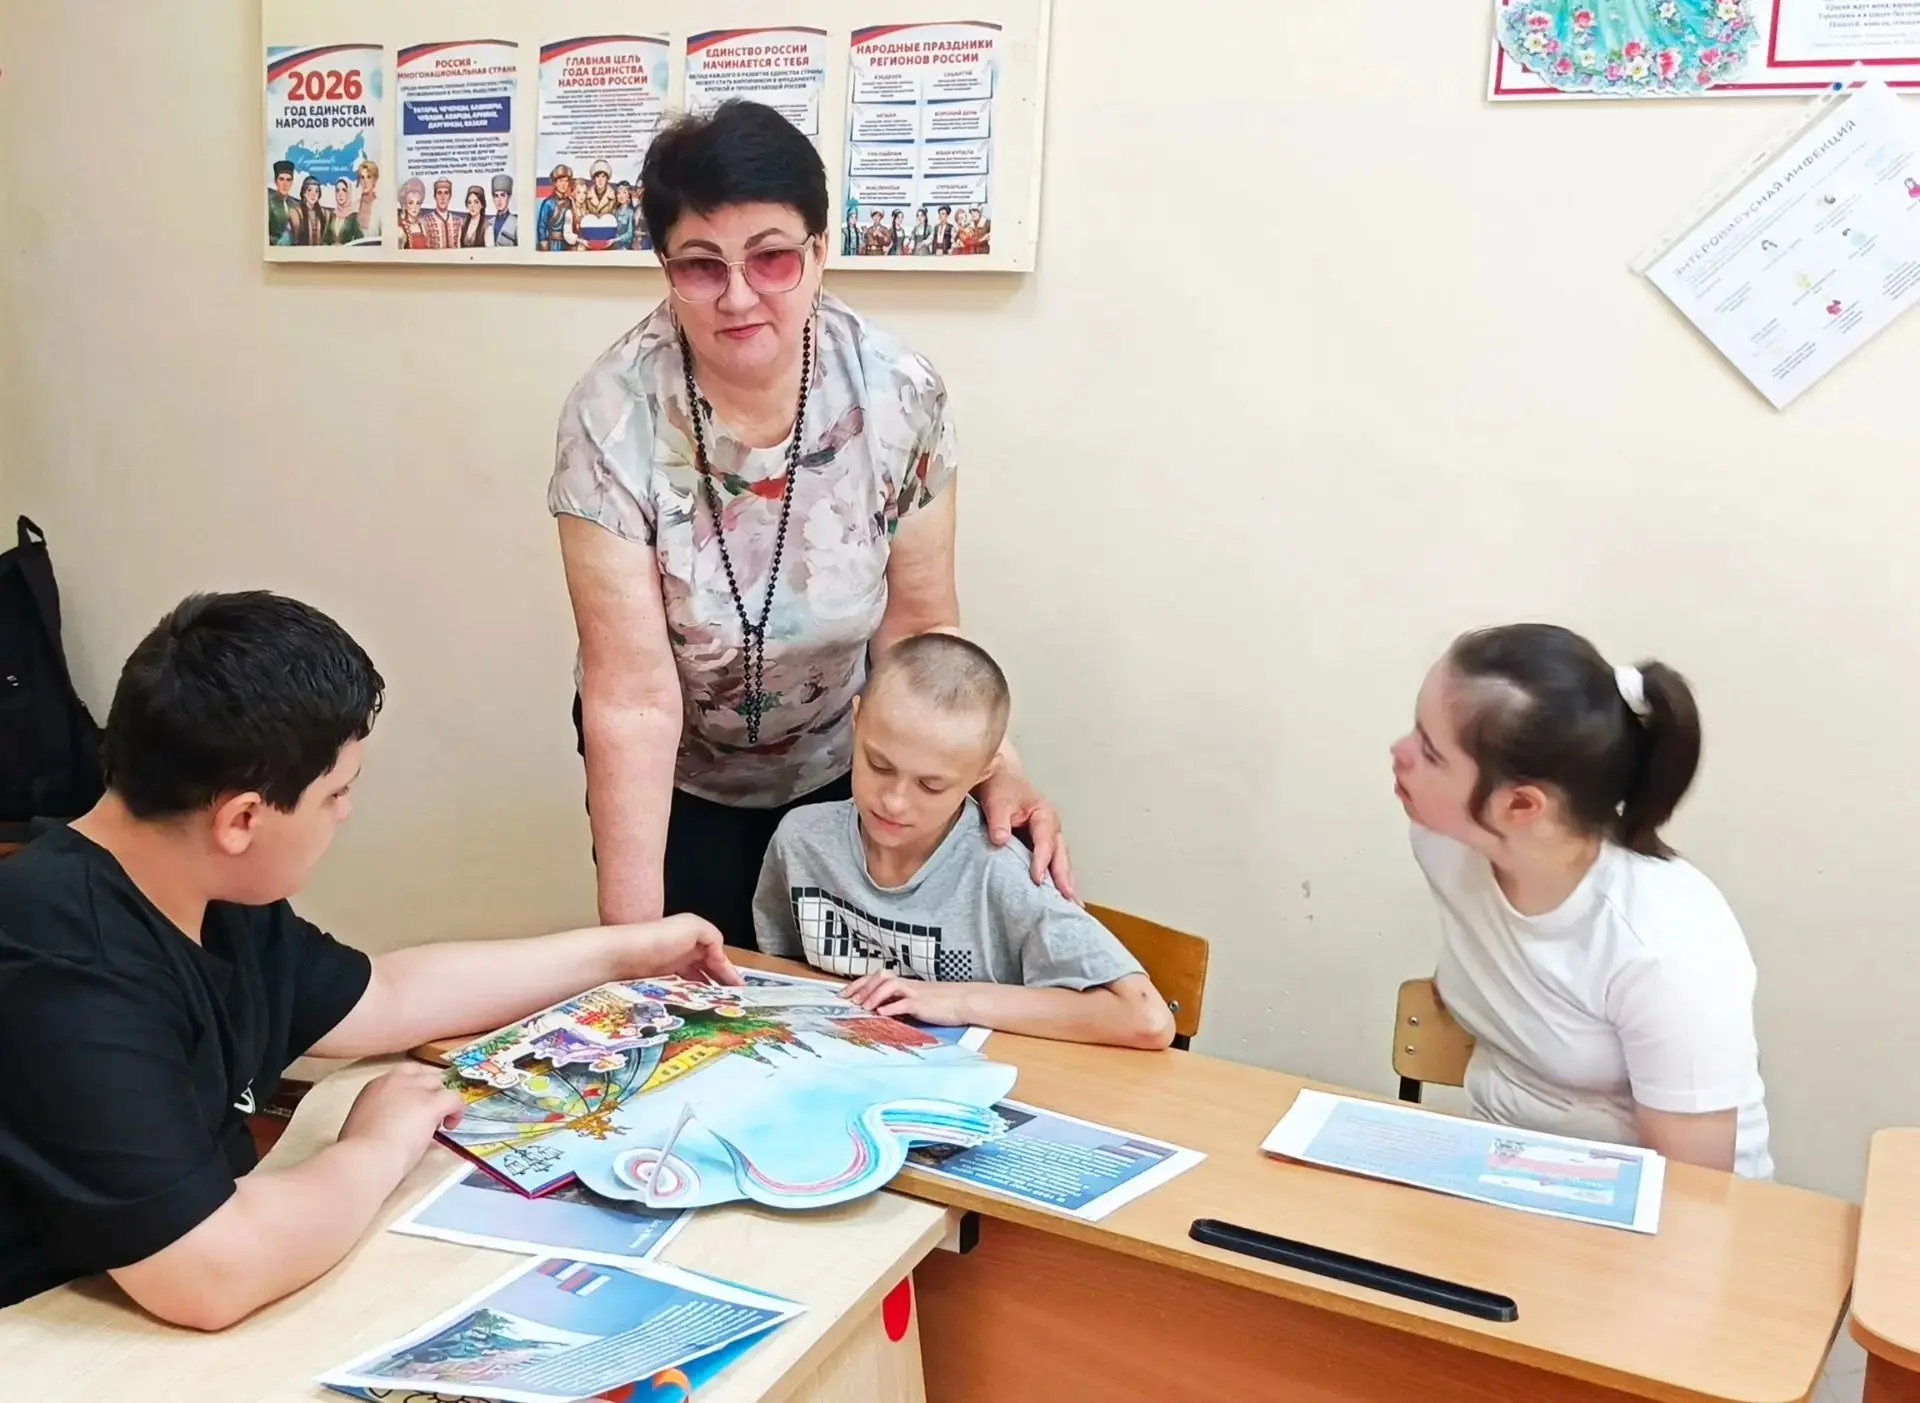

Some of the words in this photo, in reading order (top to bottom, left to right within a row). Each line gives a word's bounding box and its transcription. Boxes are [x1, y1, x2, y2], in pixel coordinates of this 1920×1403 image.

[706, 46, 762, 58] ЕДИНСТВО
[764, 44, 807, 55] РОССИИ
[856, 43, 921, 54] НАРОДНЫЕ
[923, 39, 993, 52] ПРАЗДНИКИ
[435, 58, 471, 68] РОССИЯ
[566, 56, 611, 66] ГЛАВНАЯ
[613, 55, 641, 65] ЦЕЛЬ
[703, 59, 772, 70] НАЧИНАЕТСЯ
[774, 58, 780, 67] С
[784, 57, 809, 67] ТЕБЯ
[870, 55, 930, 67] РЕГИОНОВ
[932, 53, 979, 64] РОССИИ
[397, 68, 486, 80] МНОГОНАЦИОНАЛЬНАЯ
[488, 66, 516, 74] СТРАНА
[562, 67, 589, 76] ГОДА
[591, 65, 644, 76] ЕДИНСТВА
[288, 69, 362, 101] 2026
[558, 78, 606, 87] НАРОДОВ
[608, 76, 648, 85] РОССИИ
[284, 106, 307, 116] ГОД
[310, 105, 367, 116] ЕДИНСТВА
[276, 118, 329, 128] НАРОДОВ
[332, 117, 374, 128] РОССИИ
[1673, 181, 1784, 277] ЭНТЕРОВИРУСНАЯ
[1783, 120, 1856, 183] ИНФЕКЦИЯ
